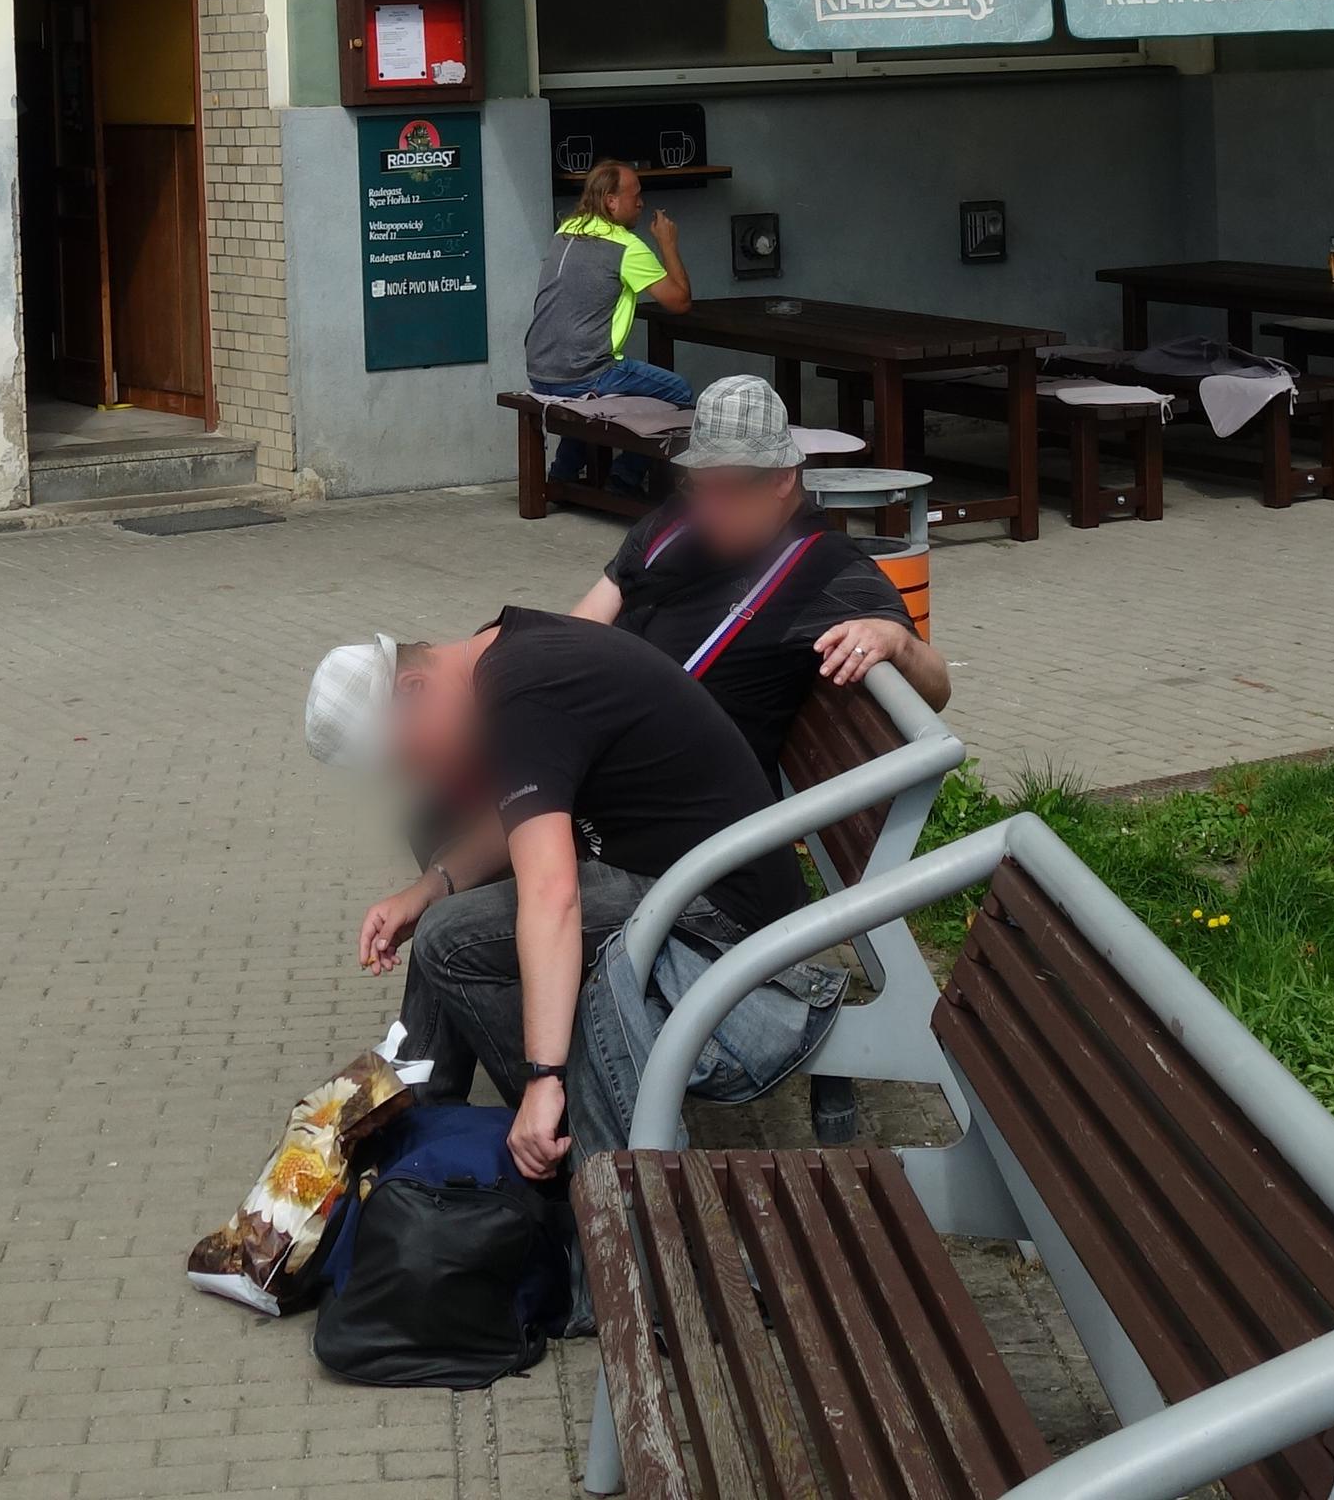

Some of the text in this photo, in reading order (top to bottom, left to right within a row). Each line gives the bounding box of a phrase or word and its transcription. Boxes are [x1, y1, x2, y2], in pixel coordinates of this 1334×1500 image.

[387, 150, 455, 170] RADEGAST
[369, 249, 442, 264] Radegast Rázná 10
[387, 276, 460, 296] NOVÉ PIVO NA ČEPU
